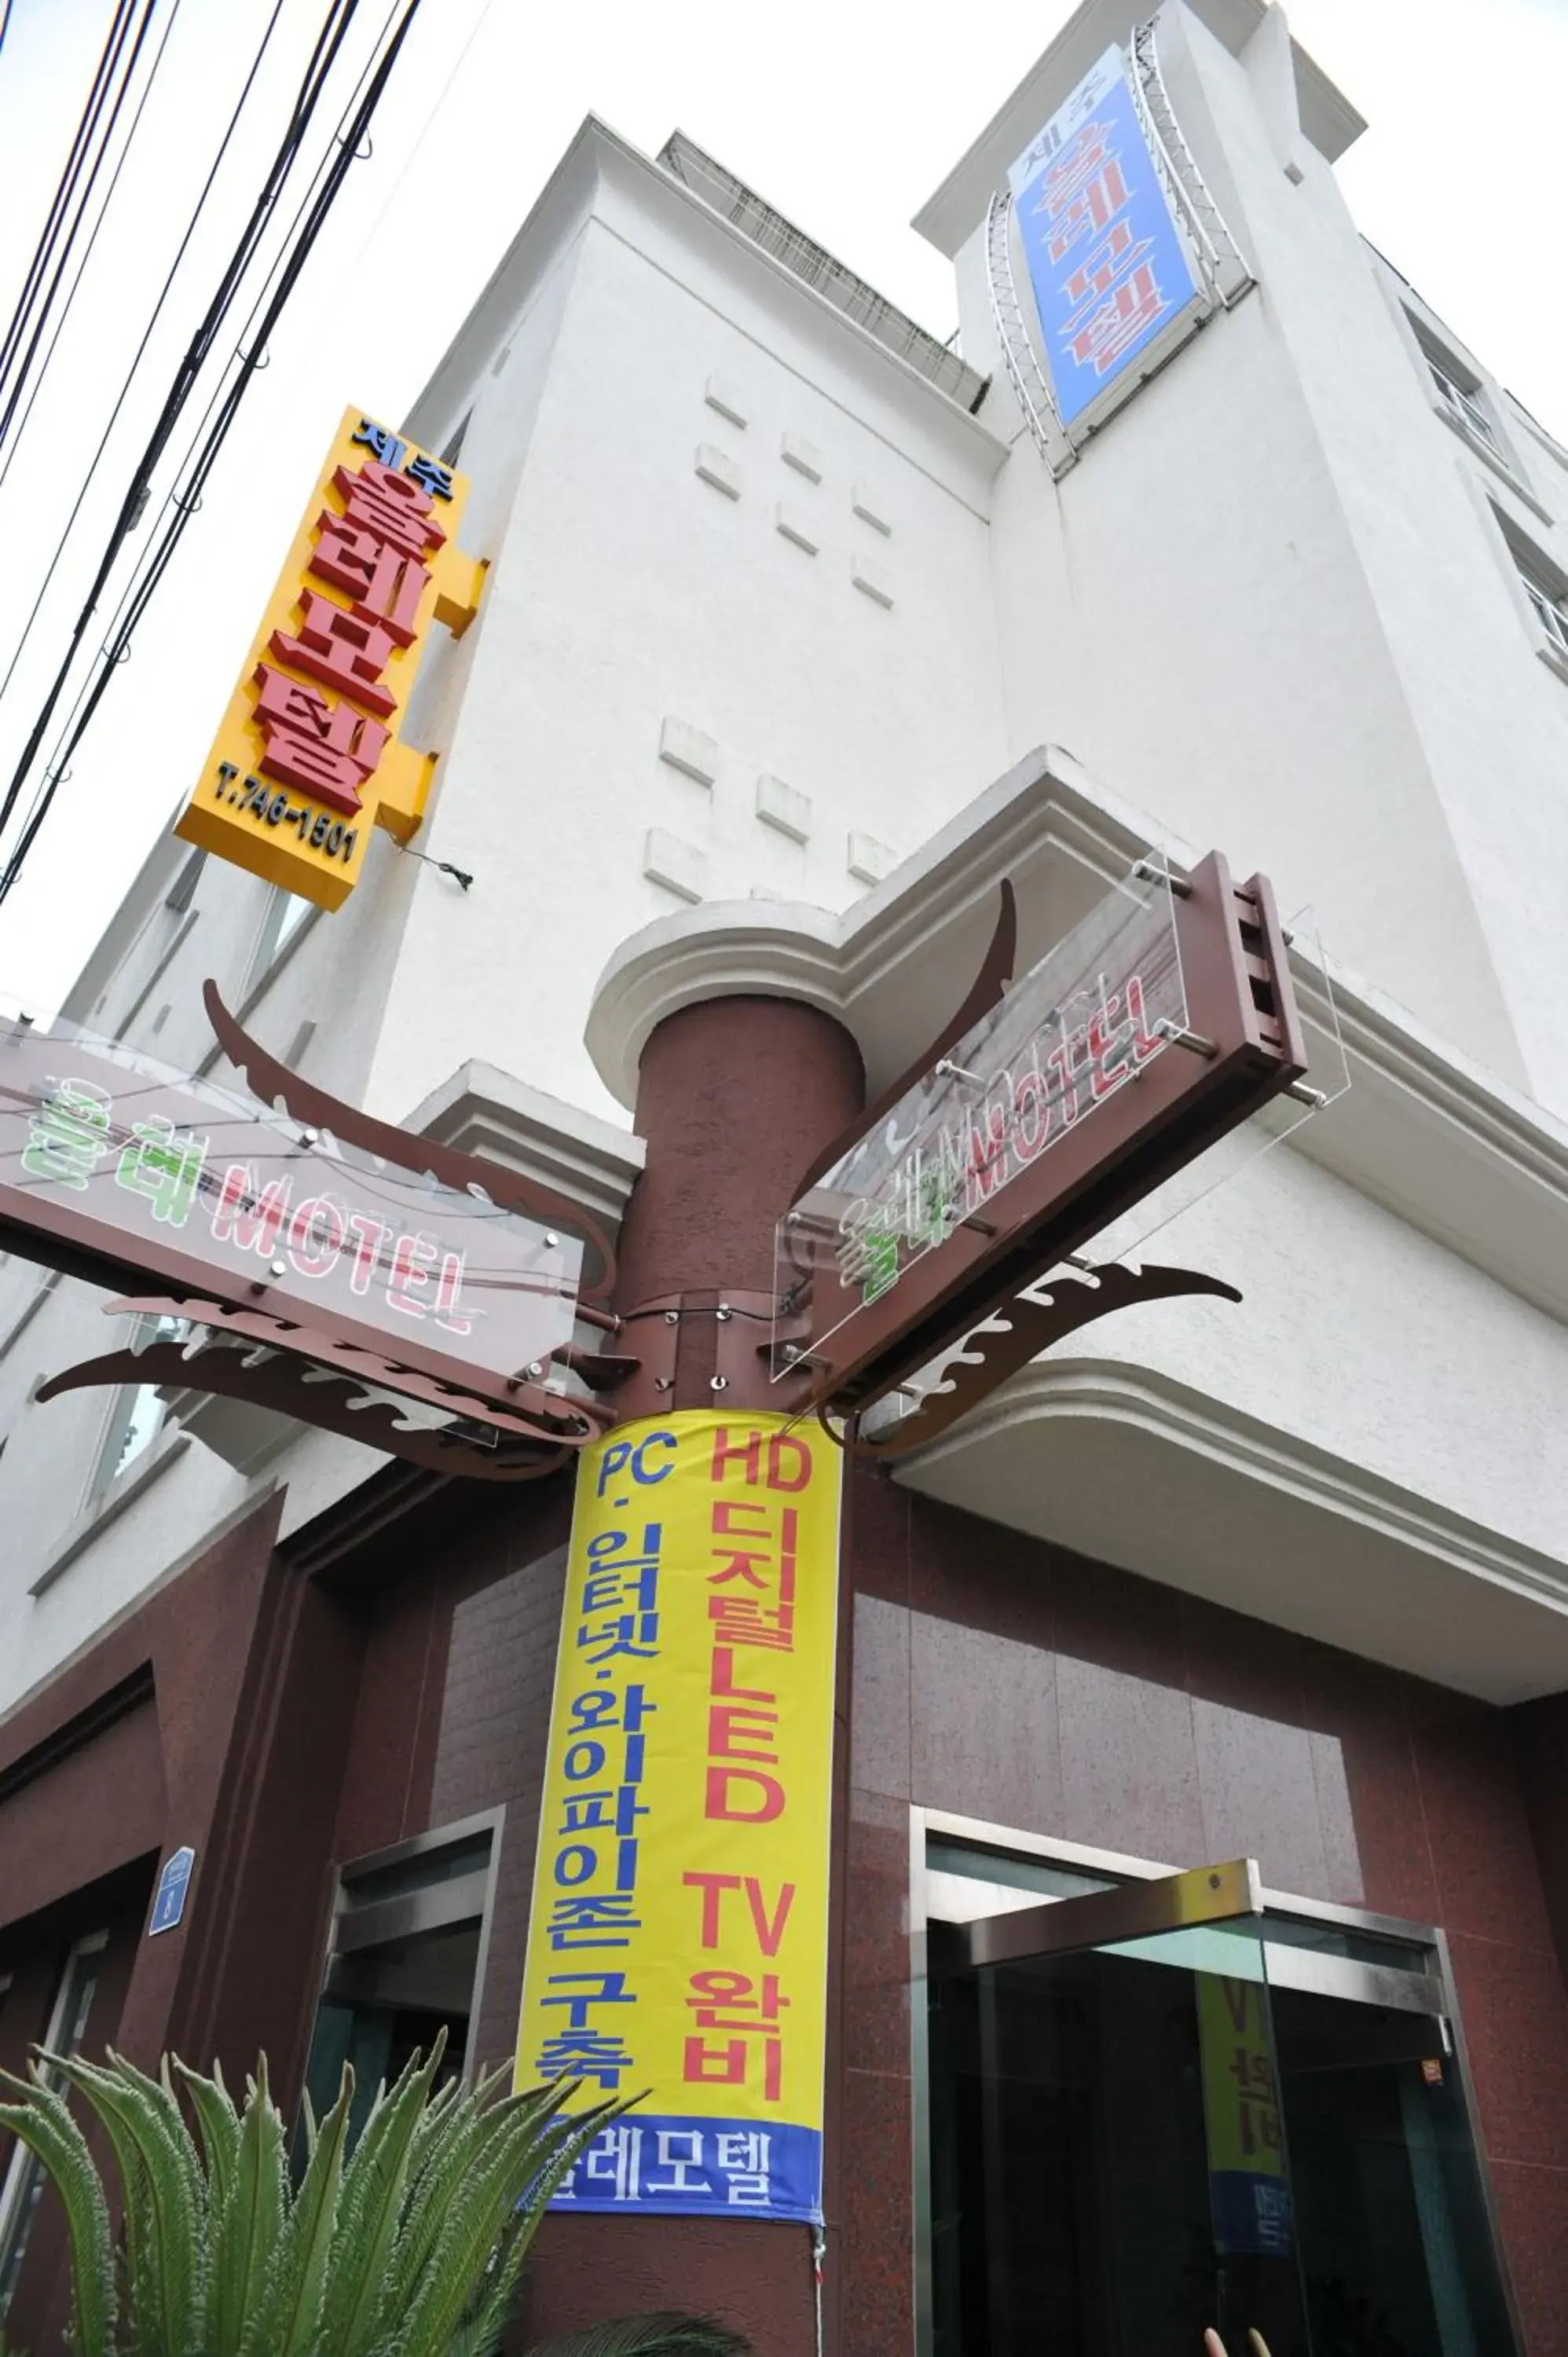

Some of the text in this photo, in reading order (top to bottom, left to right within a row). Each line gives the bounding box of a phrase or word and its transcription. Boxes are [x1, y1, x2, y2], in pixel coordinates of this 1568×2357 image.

[1023, 71, 1108, 178] 제주
[1031, 117, 1174, 377] 올레모텔
[351, 417, 454, 504] 제주
[251, 459, 448, 818] 올레모텔
[965, 974, 1167, 1212] MOTEL
[211, 1161, 474, 1336] MOTEL
